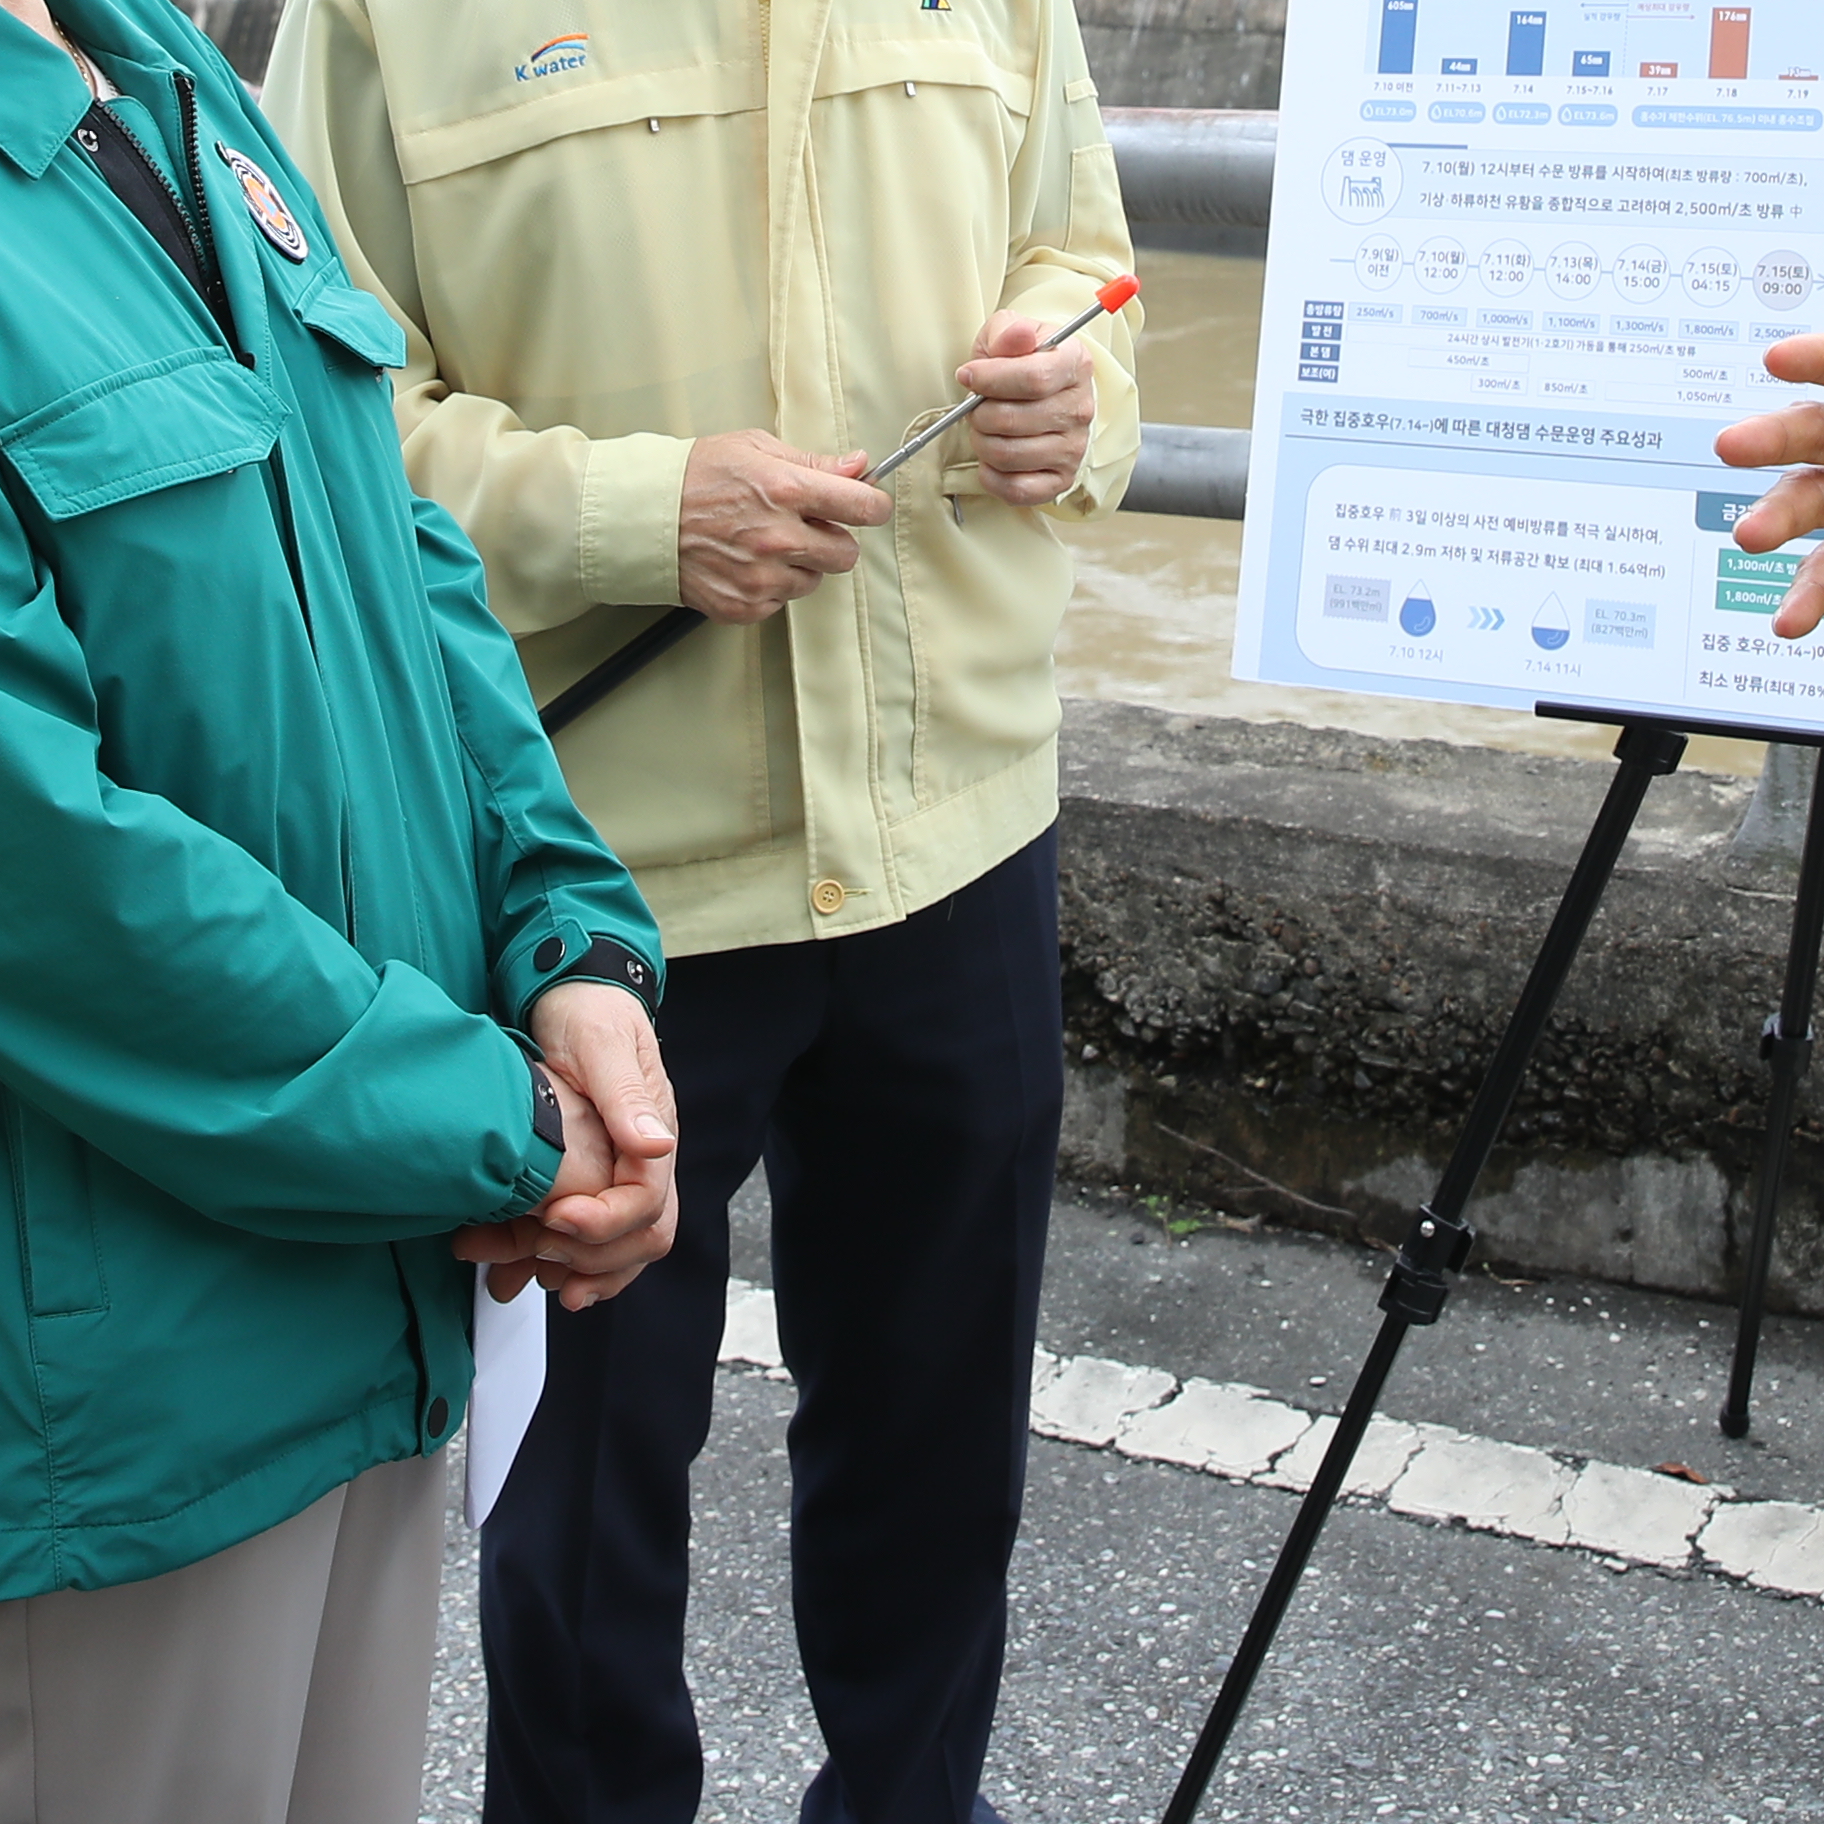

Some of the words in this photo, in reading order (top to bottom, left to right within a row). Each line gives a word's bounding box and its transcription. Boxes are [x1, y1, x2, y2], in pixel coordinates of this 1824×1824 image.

[1396, 82, 1413, 94] 이전
[1513, 84, 1533, 94] 7.14
[1647, 86, 1668, 97] 7.17
[1716, 88, 1737, 98] 7.18
[1787, 89, 1809, 100] 7.19
[1342, 150, 1354, 167] 댐
[1359, 150, 1386, 168] 운영
[1422, 161, 1475, 176] 7.10(월)
[1480, 162, 1534, 177] 12시부터
[1539, 163, 1564, 178] 수문
[1568, 164, 1607, 180] 방류를
[1612, 165, 1693, 183] 시작하여(최초
[1697, 168, 1731, 184] 방류량
[1505, 195, 1543, 212] 유황을
[1548, 196, 1613, 213] 종합적으로
[1617, 199, 1671, 215] 고려하여
[1756, 203, 1784, 219] 방류
[1361, 249, 1399, 262] 7.9(일)
[1418, 250, 1465, 265] 7.10(월)
[1483, 253, 1531, 268] 7.11(화)
[1368, 264, 1389, 278] 이전
[1550, 256, 1598, 271] 7.13(목)
[1618, 259, 1667, 274] 7.14(금)
[1687, 262, 1738, 277] 7.15(토)
[1424, 267, 1458, 279] 12:00
[1489, 270, 1524, 282] 12:00
[1556, 273, 1591, 286] 14:00
[1758, 265, 1809, 280] 7.15(토)
[1624, 276, 1660, 288] 15:00
[1691, 279, 1730, 292] 04:15
[1762, 282, 1802, 295] 09:00
[1677, 346, 1696, 357] 방류
[1301, 408, 1328, 426] 극한
[1452, 419, 1481, 437] 따른
[1486, 421, 1530, 440] 대청댐
[1535, 425, 1595, 446] 수문운영
[1600, 429, 1663, 449] 주요성과
[1335, 503, 1384, 522] 집중호우
[1406, 510, 1427, 525] 3일
[1431, 511, 1469, 528] 이상의
[1473, 514, 1499, 530] 사전
[1503, 516, 1569, 538] 예비방류를
[1574, 521, 1600, 540] 적극
[1604, 524, 1663, 545] 실시하여,
[1329, 536, 1340, 551] 댐
[1344, 537, 1369, 553] 수위
[1373, 539, 1398, 555] 최대
[1401, 542, 1437, 558] 2.9m
[1441, 545, 1467, 561] 저하
[1471, 547, 1483, 563] 및
[1487, 549, 1539, 568] 저류공간
[1543, 554, 1570, 570] 확보
[1574, 557, 1603, 574] (최대
[1613, 610, 1646, 623] 70.3m
[1702, 633, 1731, 652] 집중
[1389, 645, 1414, 659] 7.10
[1418, 647, 1443, 663] 12시
[1525, 660, 1551, 673] 7.14
[1555, 663, 1581, 677] 11시
[1699, 671, 1728, 689] 최소
[1734, 674, 1795, 695] 방류(최대
